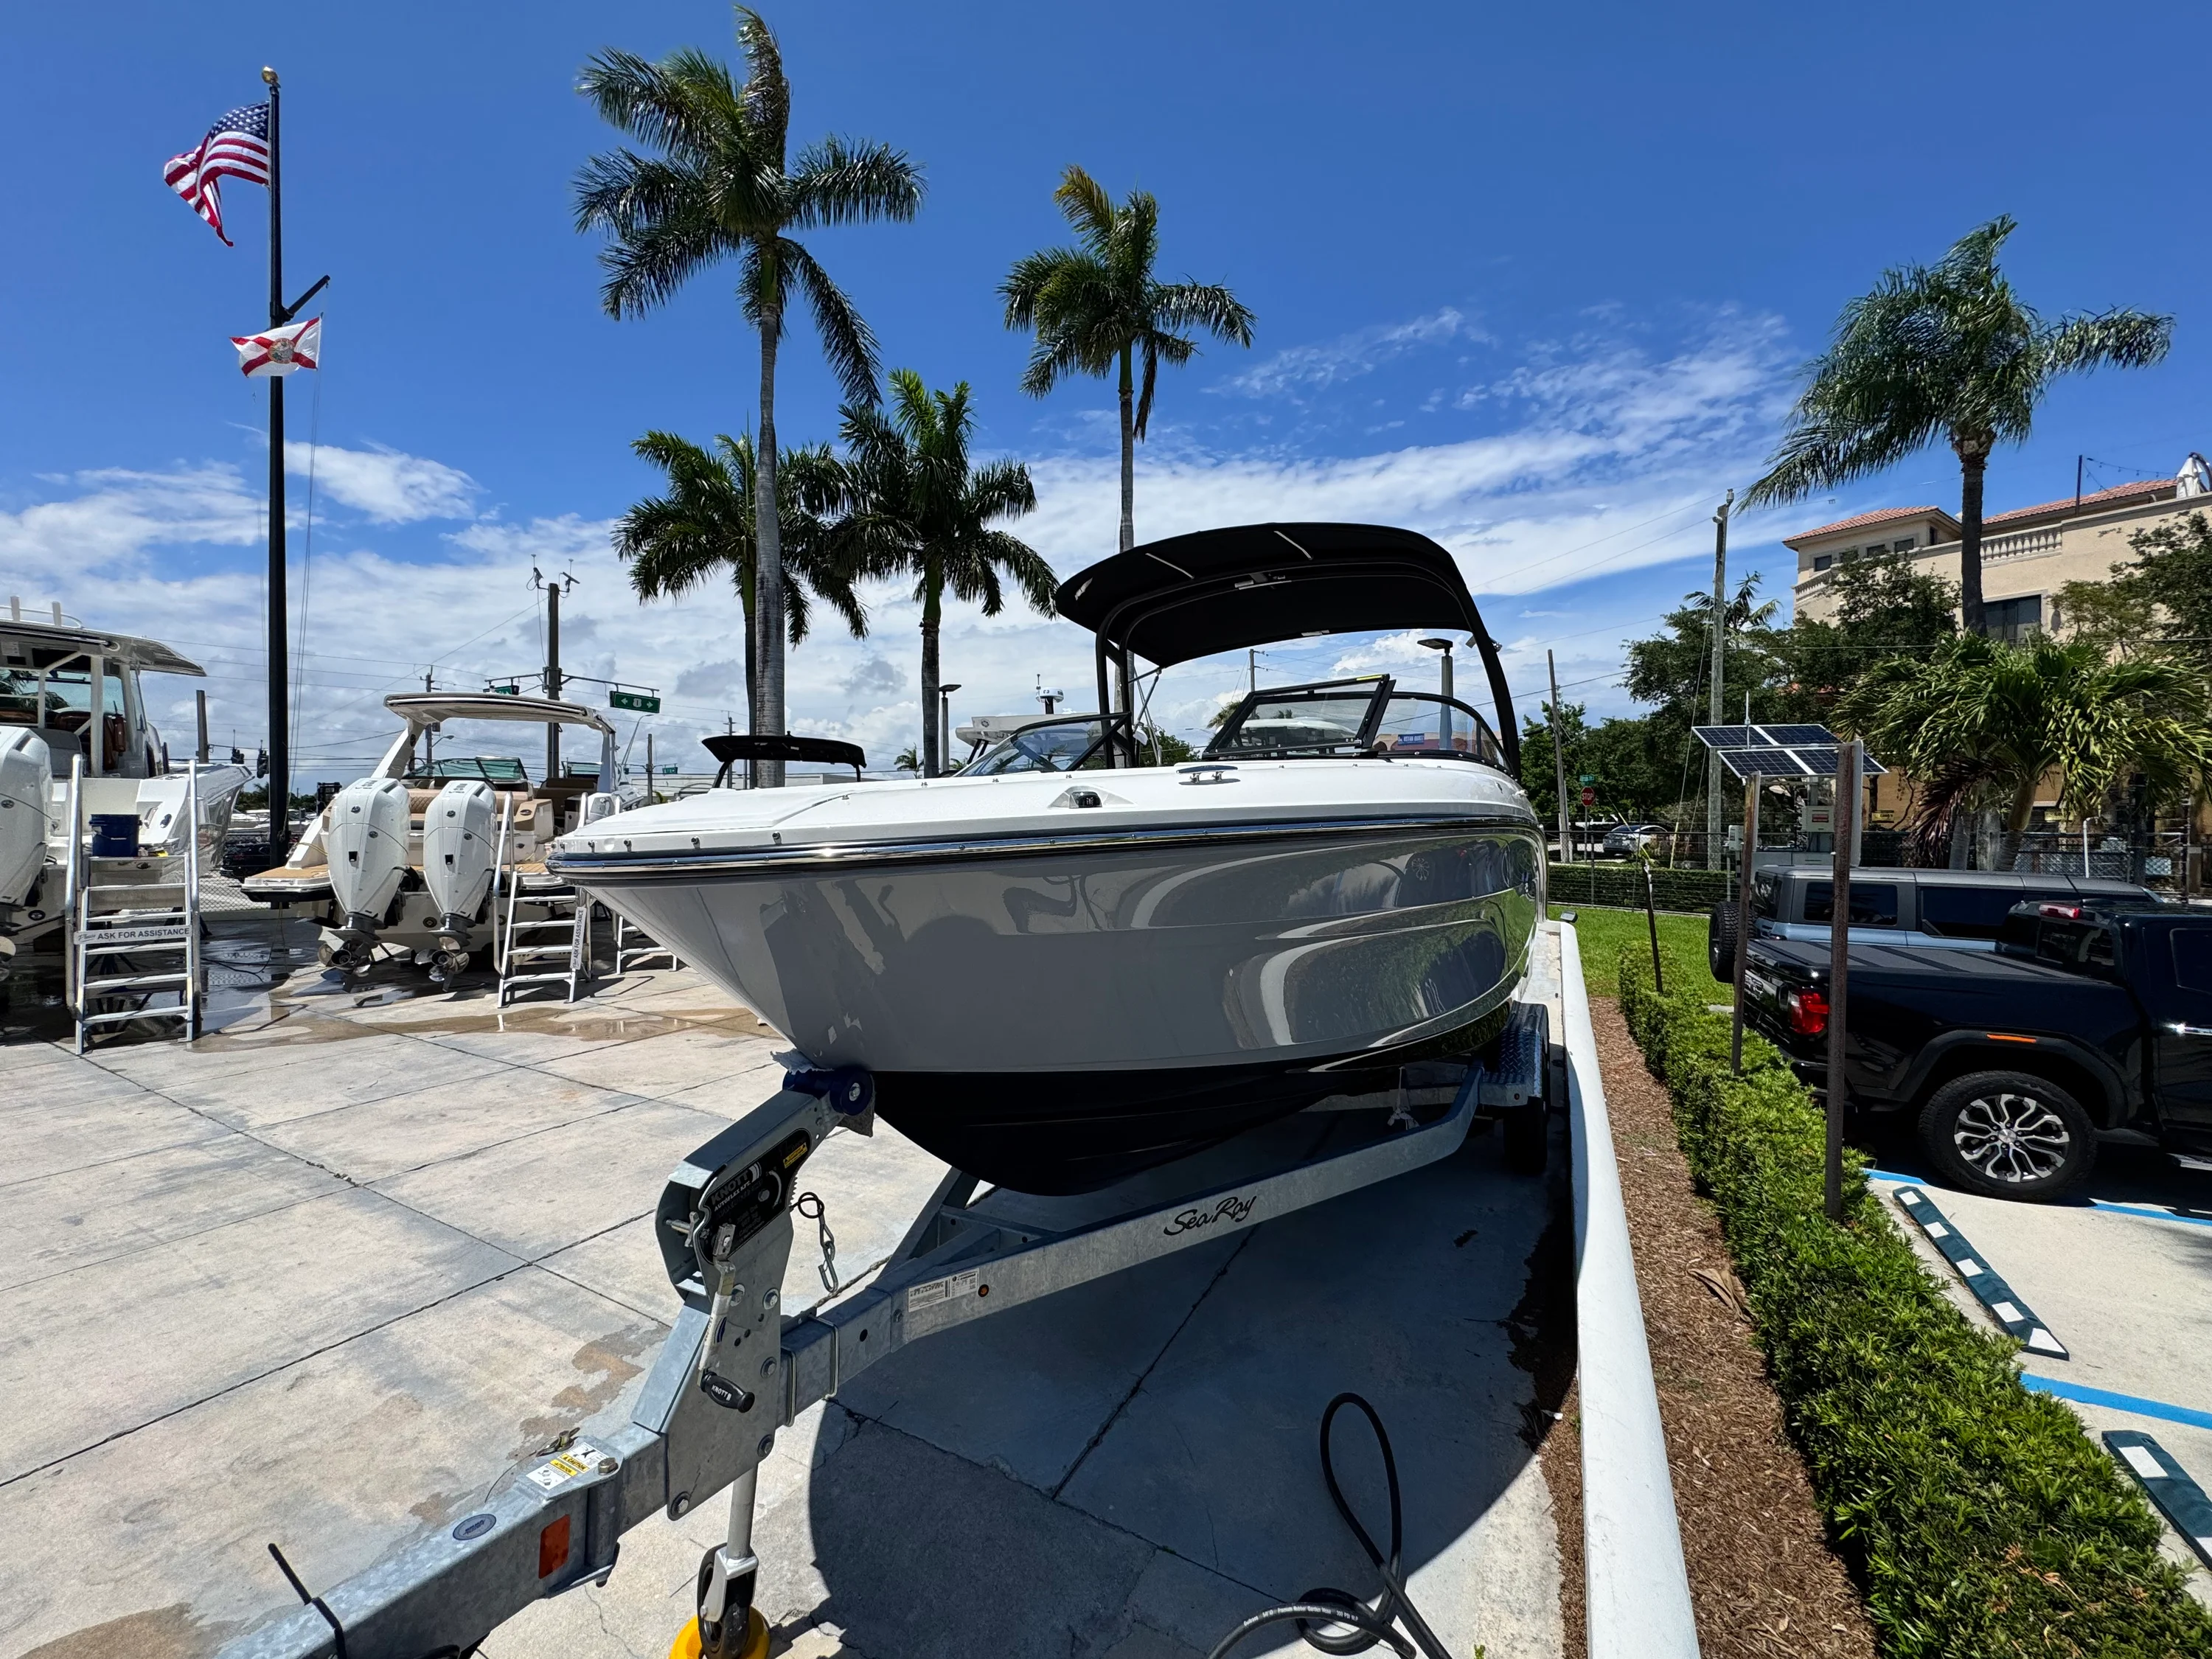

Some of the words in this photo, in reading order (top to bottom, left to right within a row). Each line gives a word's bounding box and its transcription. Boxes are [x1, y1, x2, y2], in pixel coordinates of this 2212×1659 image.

[1582, 793, 1593, 801] STOP
[576, 910, 584, 938] ASSISTANCE
[97, 932, 116, 940] ASK
[118, 931, 136, 939] FOR
[138, 928, 189, 938] ASSISTANCE
[711, 1169, 750, 1205] KNOTT
[1164, 1208, 1214, 1236] Sea
[1211, 1196, 1257, 1223] Ray
[712, 1384, 728, 1398] KNOTT
[567, 1457, 586, 1470] CAUTION
